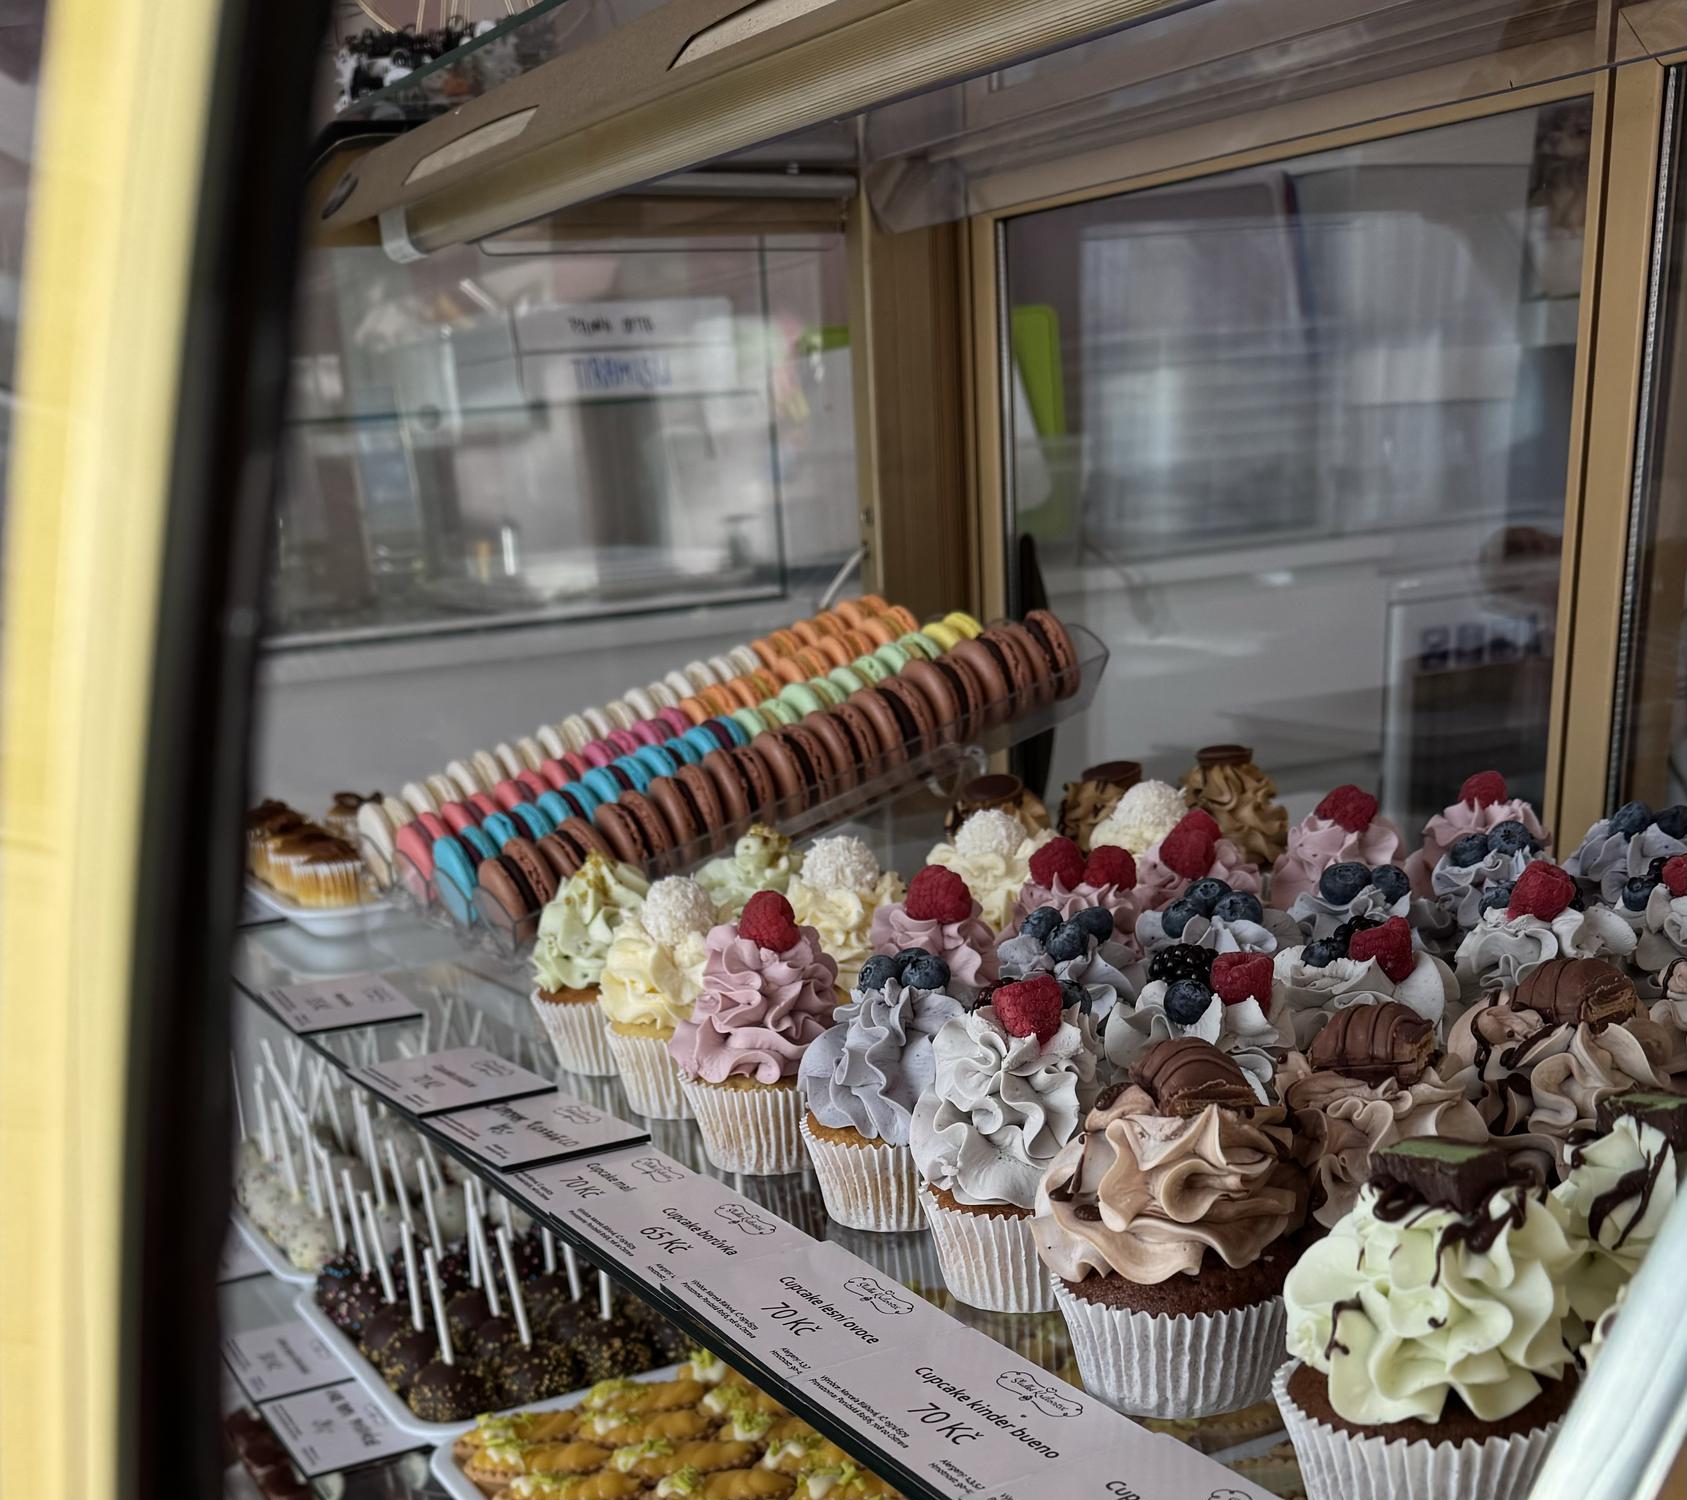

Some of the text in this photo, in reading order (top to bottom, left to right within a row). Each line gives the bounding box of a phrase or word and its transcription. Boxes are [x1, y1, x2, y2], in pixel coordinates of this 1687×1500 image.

[559, 1175, 580, 1188] 70
[578, 1185, 606, 1199] Kč
[586, 1162, 618, 1183] Cupcake
[640, 1225, 694, 1255] 65 Kč
[662, 1207, 701, 1233] Cupcake
[697, 1228, 738, 1256] borůvka
[760, 1302, 823, 1337] 70 Kč
[779, 1276, 880, 1345] Cupcake lesní ovoce
[907, 1403, 985, 1446] 70 Kč
[914, 1366, 1060, 1459] Cupcake kinder bueno
